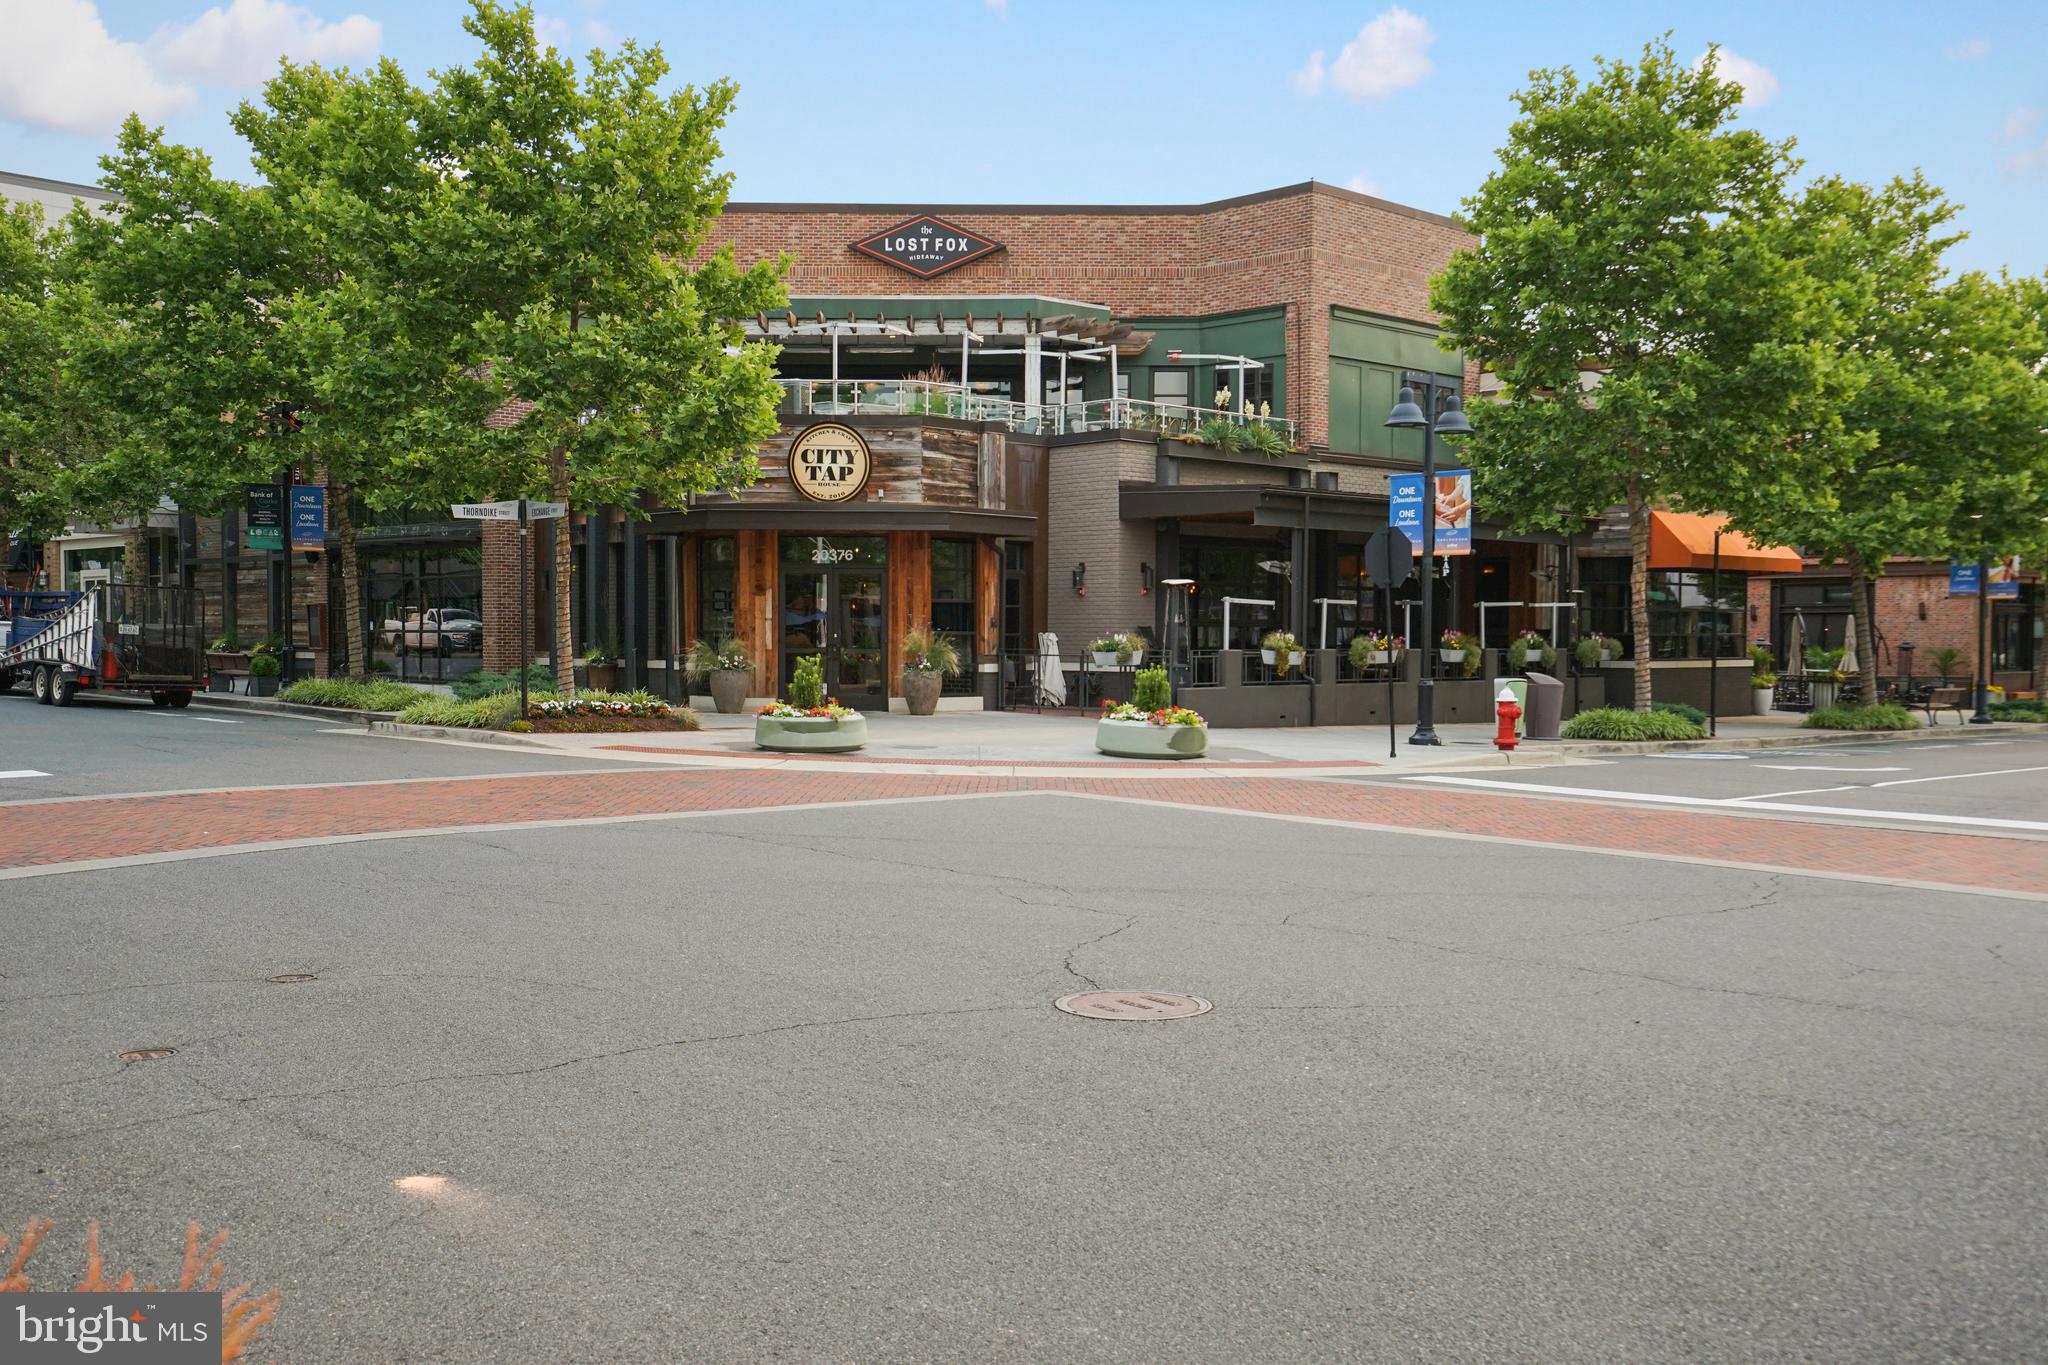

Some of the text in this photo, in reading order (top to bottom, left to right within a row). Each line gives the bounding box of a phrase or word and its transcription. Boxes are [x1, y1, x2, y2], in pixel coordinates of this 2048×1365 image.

[920, 225, 933, 235] the
[884, 237, 968, 251] LOST FOX
[806, 430, 830, 443] KITCHEN
[837, 431, 855, 443] CRAFT
[800, 448, 859, 465] CITY
[805, 465, 854, 481] TAP
[828, 491, 846, 499] 2010
[1399, 486, 1416, 495] ONE
[1392, 495, 1422, 504] Downtown
[462, 507, 497, 517] THORNDIKE
[531, 506, 551, 517] EXCHANGE
[1398, 509, 1416, 518] ONE
[1394, 518, 1420, 527] Loudoun
[811, 549, 854, 561] 20376
